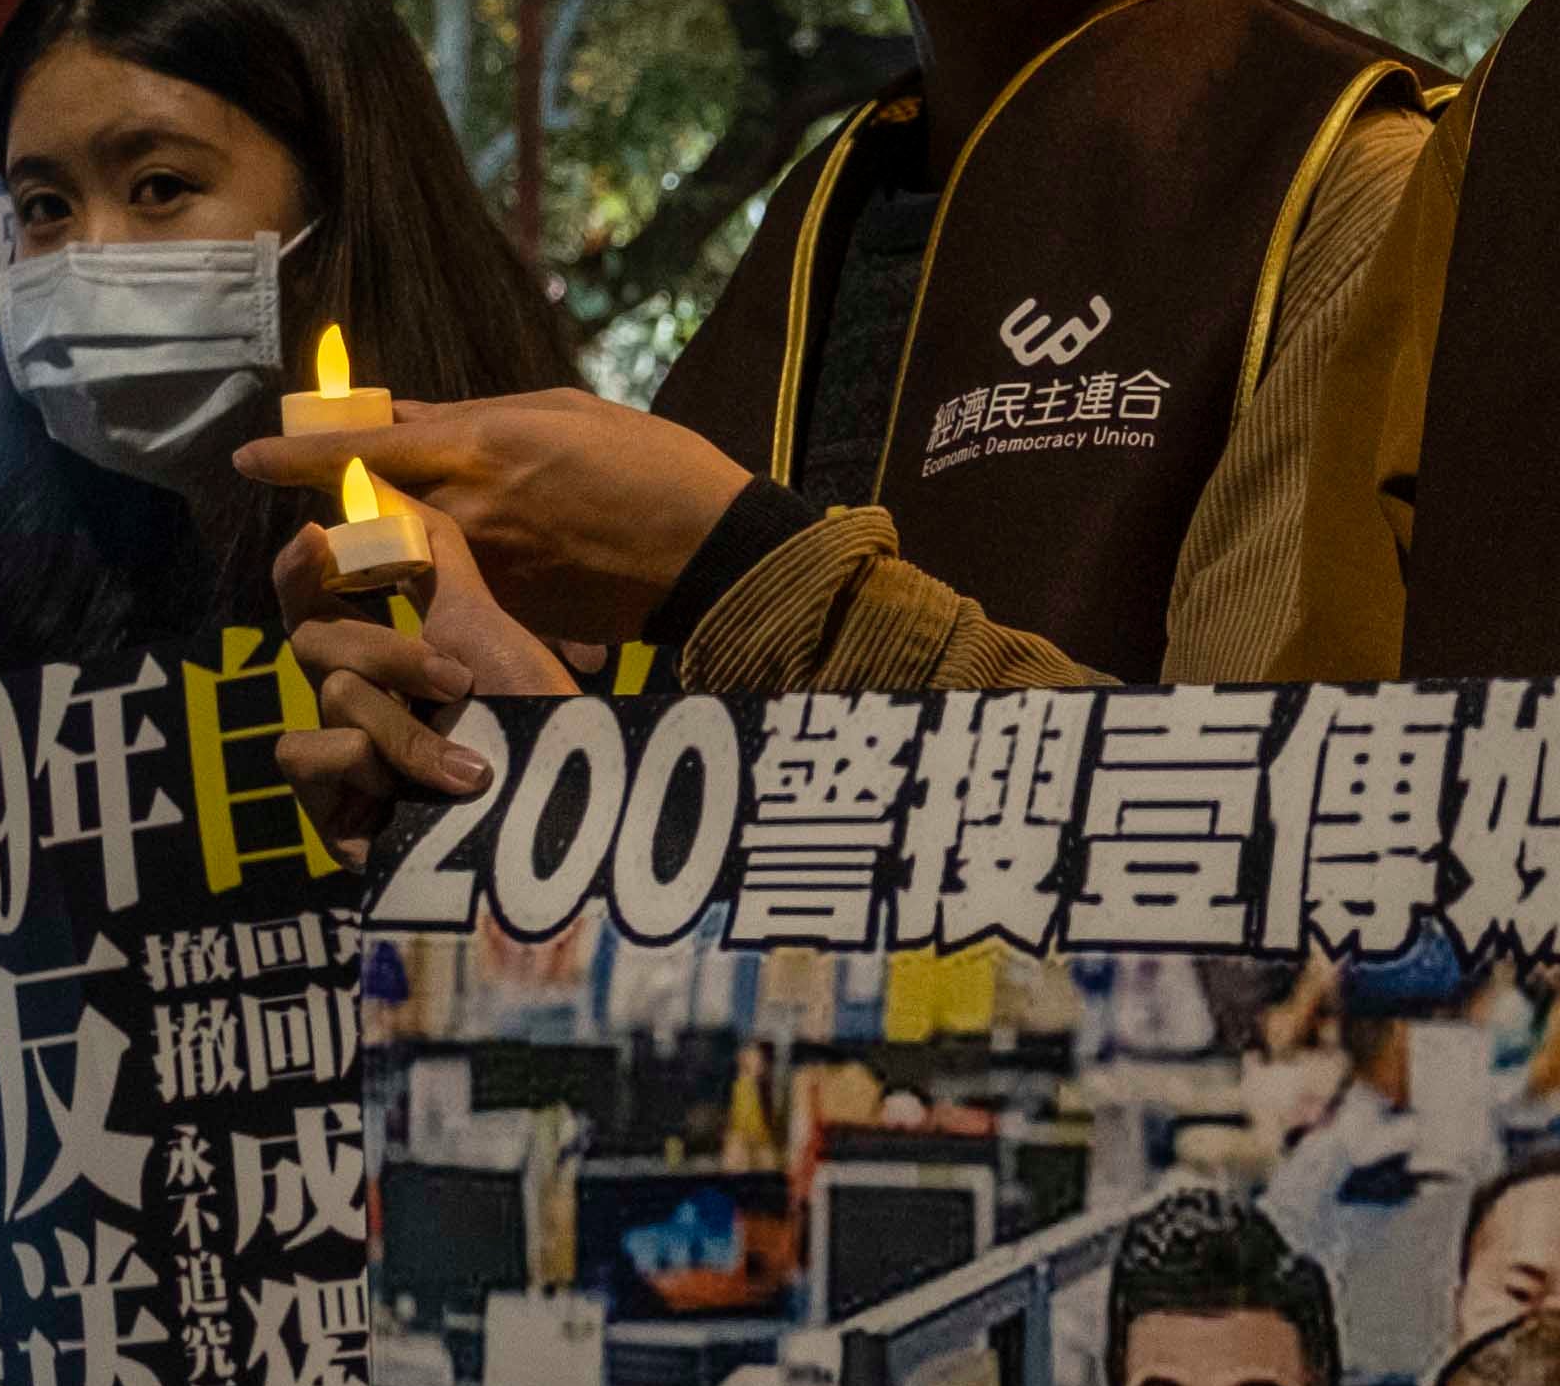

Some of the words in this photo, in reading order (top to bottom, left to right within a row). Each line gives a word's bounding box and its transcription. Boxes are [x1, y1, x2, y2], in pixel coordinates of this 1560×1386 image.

[920, 443, 981, 478] Economic
[985, 429, 1088, 457] Democracy
[1093, 425, 1156, 449] Union
[926, 369, 1171, 453] 經濟民主連合
[150, 979, 362, 1103] 撤回
